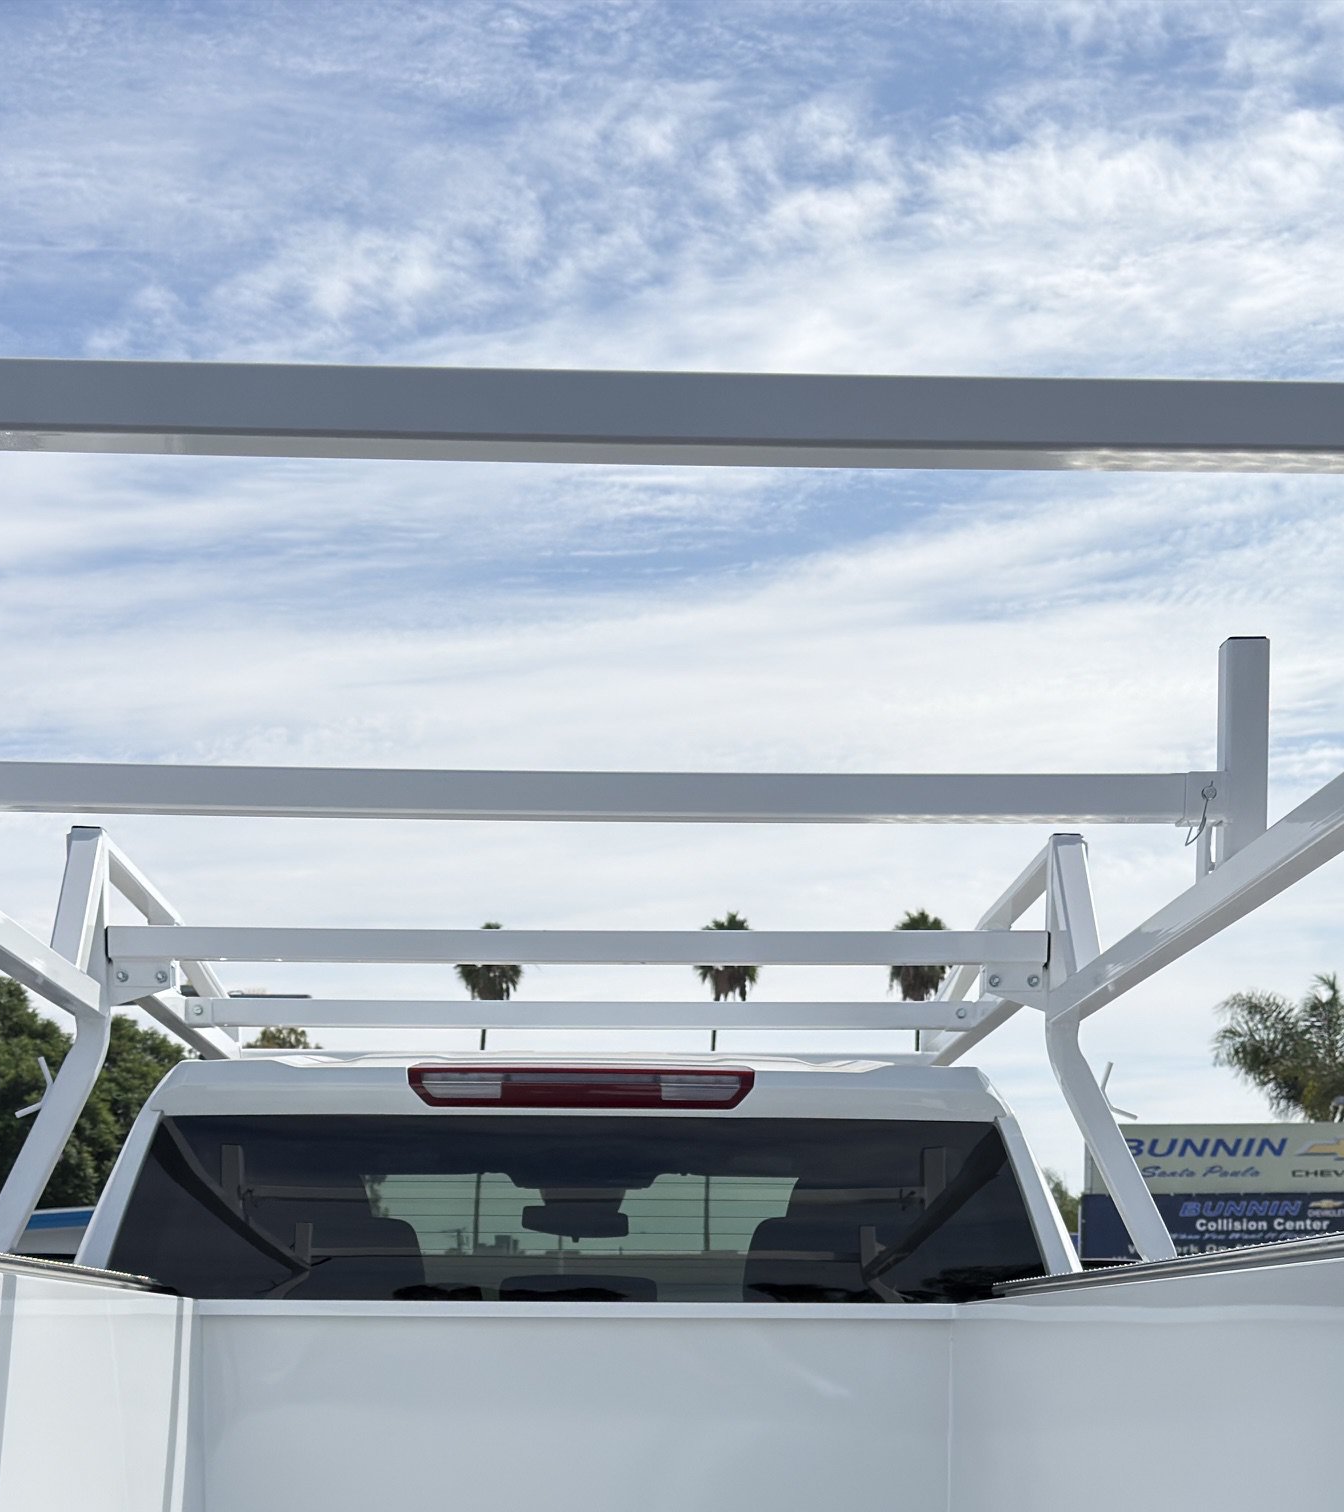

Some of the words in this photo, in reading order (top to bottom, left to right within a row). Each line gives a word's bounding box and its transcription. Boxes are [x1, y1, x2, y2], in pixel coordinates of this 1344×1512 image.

[1142, 1165, 1196, 1178] Santa
[1202, 1165, 1260, 1178] Paula
[1179, 1200, 1302, 1217] BUNNIN
[1196, 1218, 1267, 1231] Collision
[1273, 1218, 1330, 1231] Center
